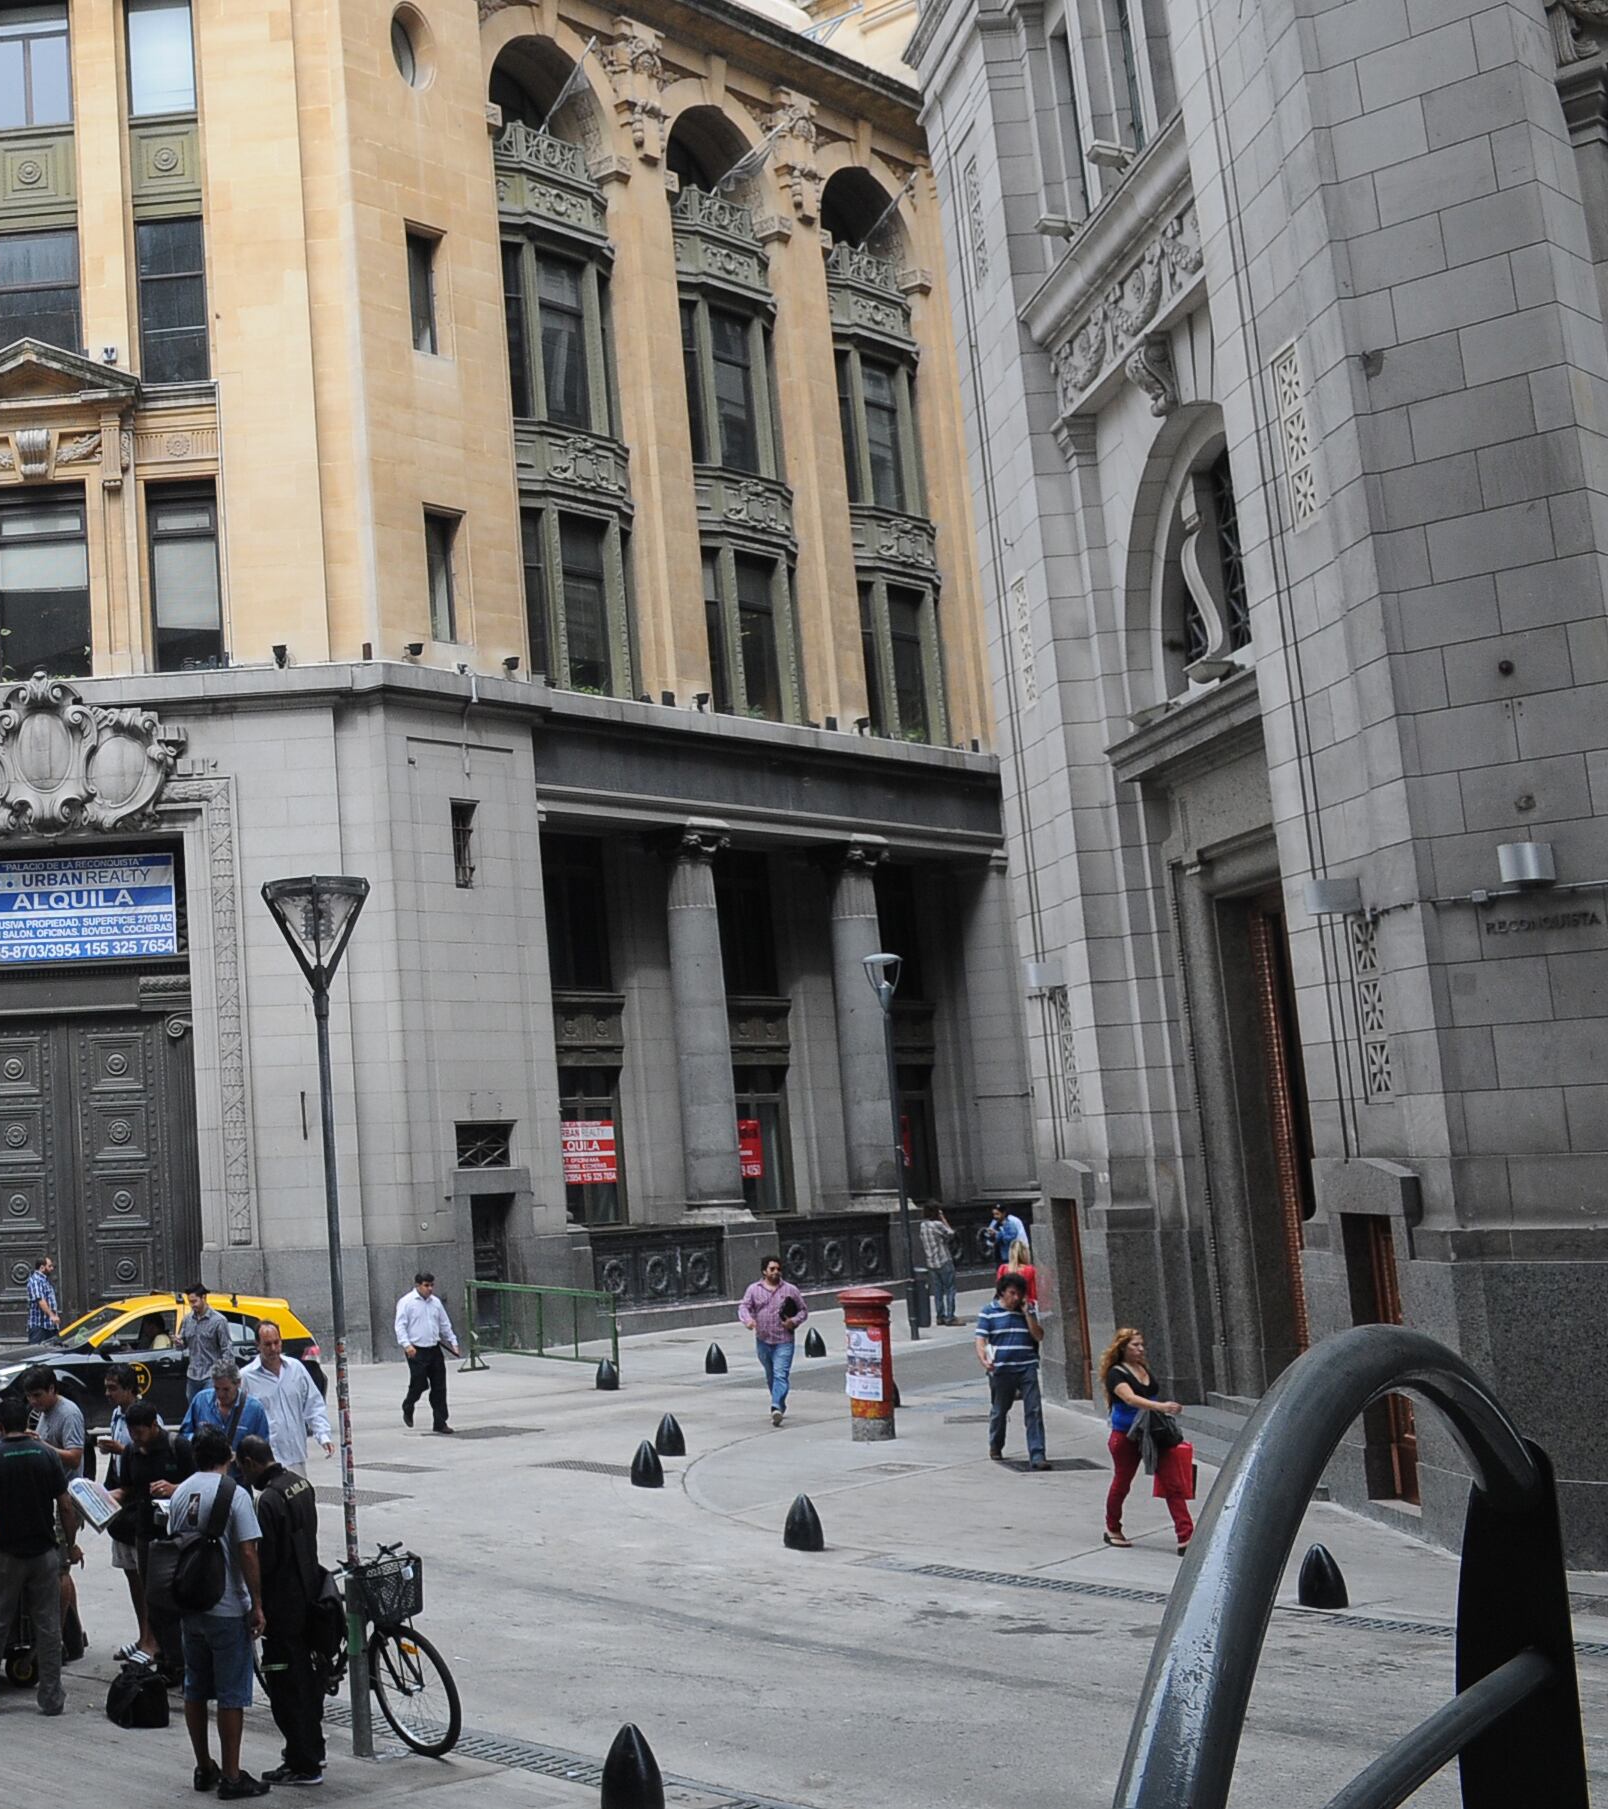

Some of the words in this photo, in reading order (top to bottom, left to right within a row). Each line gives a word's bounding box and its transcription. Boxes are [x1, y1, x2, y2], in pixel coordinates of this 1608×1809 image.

[47, 862, 59, 870] DE
[61, 861, 73, 869] LA
[22, 872, 82, 887] URBAN
[86, 868, 150, 884] REALTY
[12, 889, 134, 910] ALQUILA
[83, 916, 135, 926] SUPERFICIE
[137, 914, 158, 923] 2700
[160, 913, 172, 922] M2
[123, 923, 172, 933] COCHERAS
[84, 942, 108, 956] 155
[112, 941, 137, 954] 325
[140, 939, 173, 953] 7654
